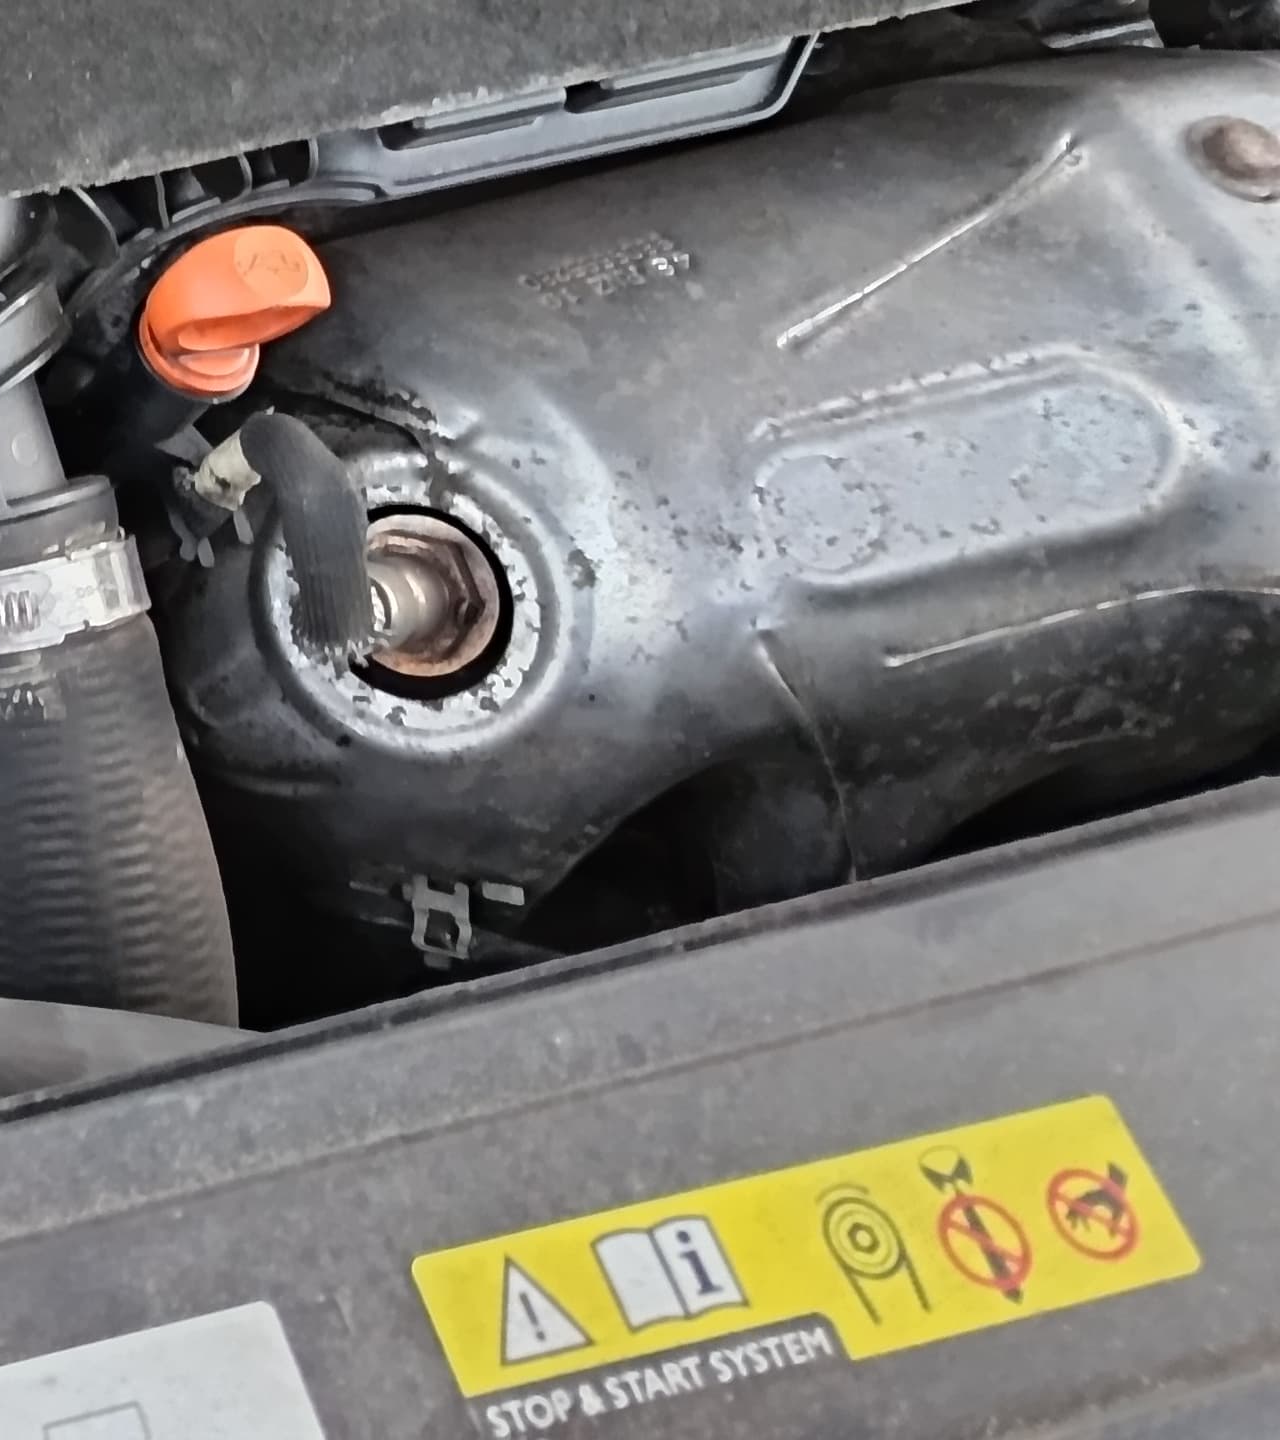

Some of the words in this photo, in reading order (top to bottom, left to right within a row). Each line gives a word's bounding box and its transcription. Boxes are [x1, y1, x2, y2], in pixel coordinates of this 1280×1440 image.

[486, 1389, 572, 1438] STOP
[578, 1384, 606, 1416] &
[604, 1356, 705, 1410] START
[709, 1327, 834, 1383] SYSTEM
